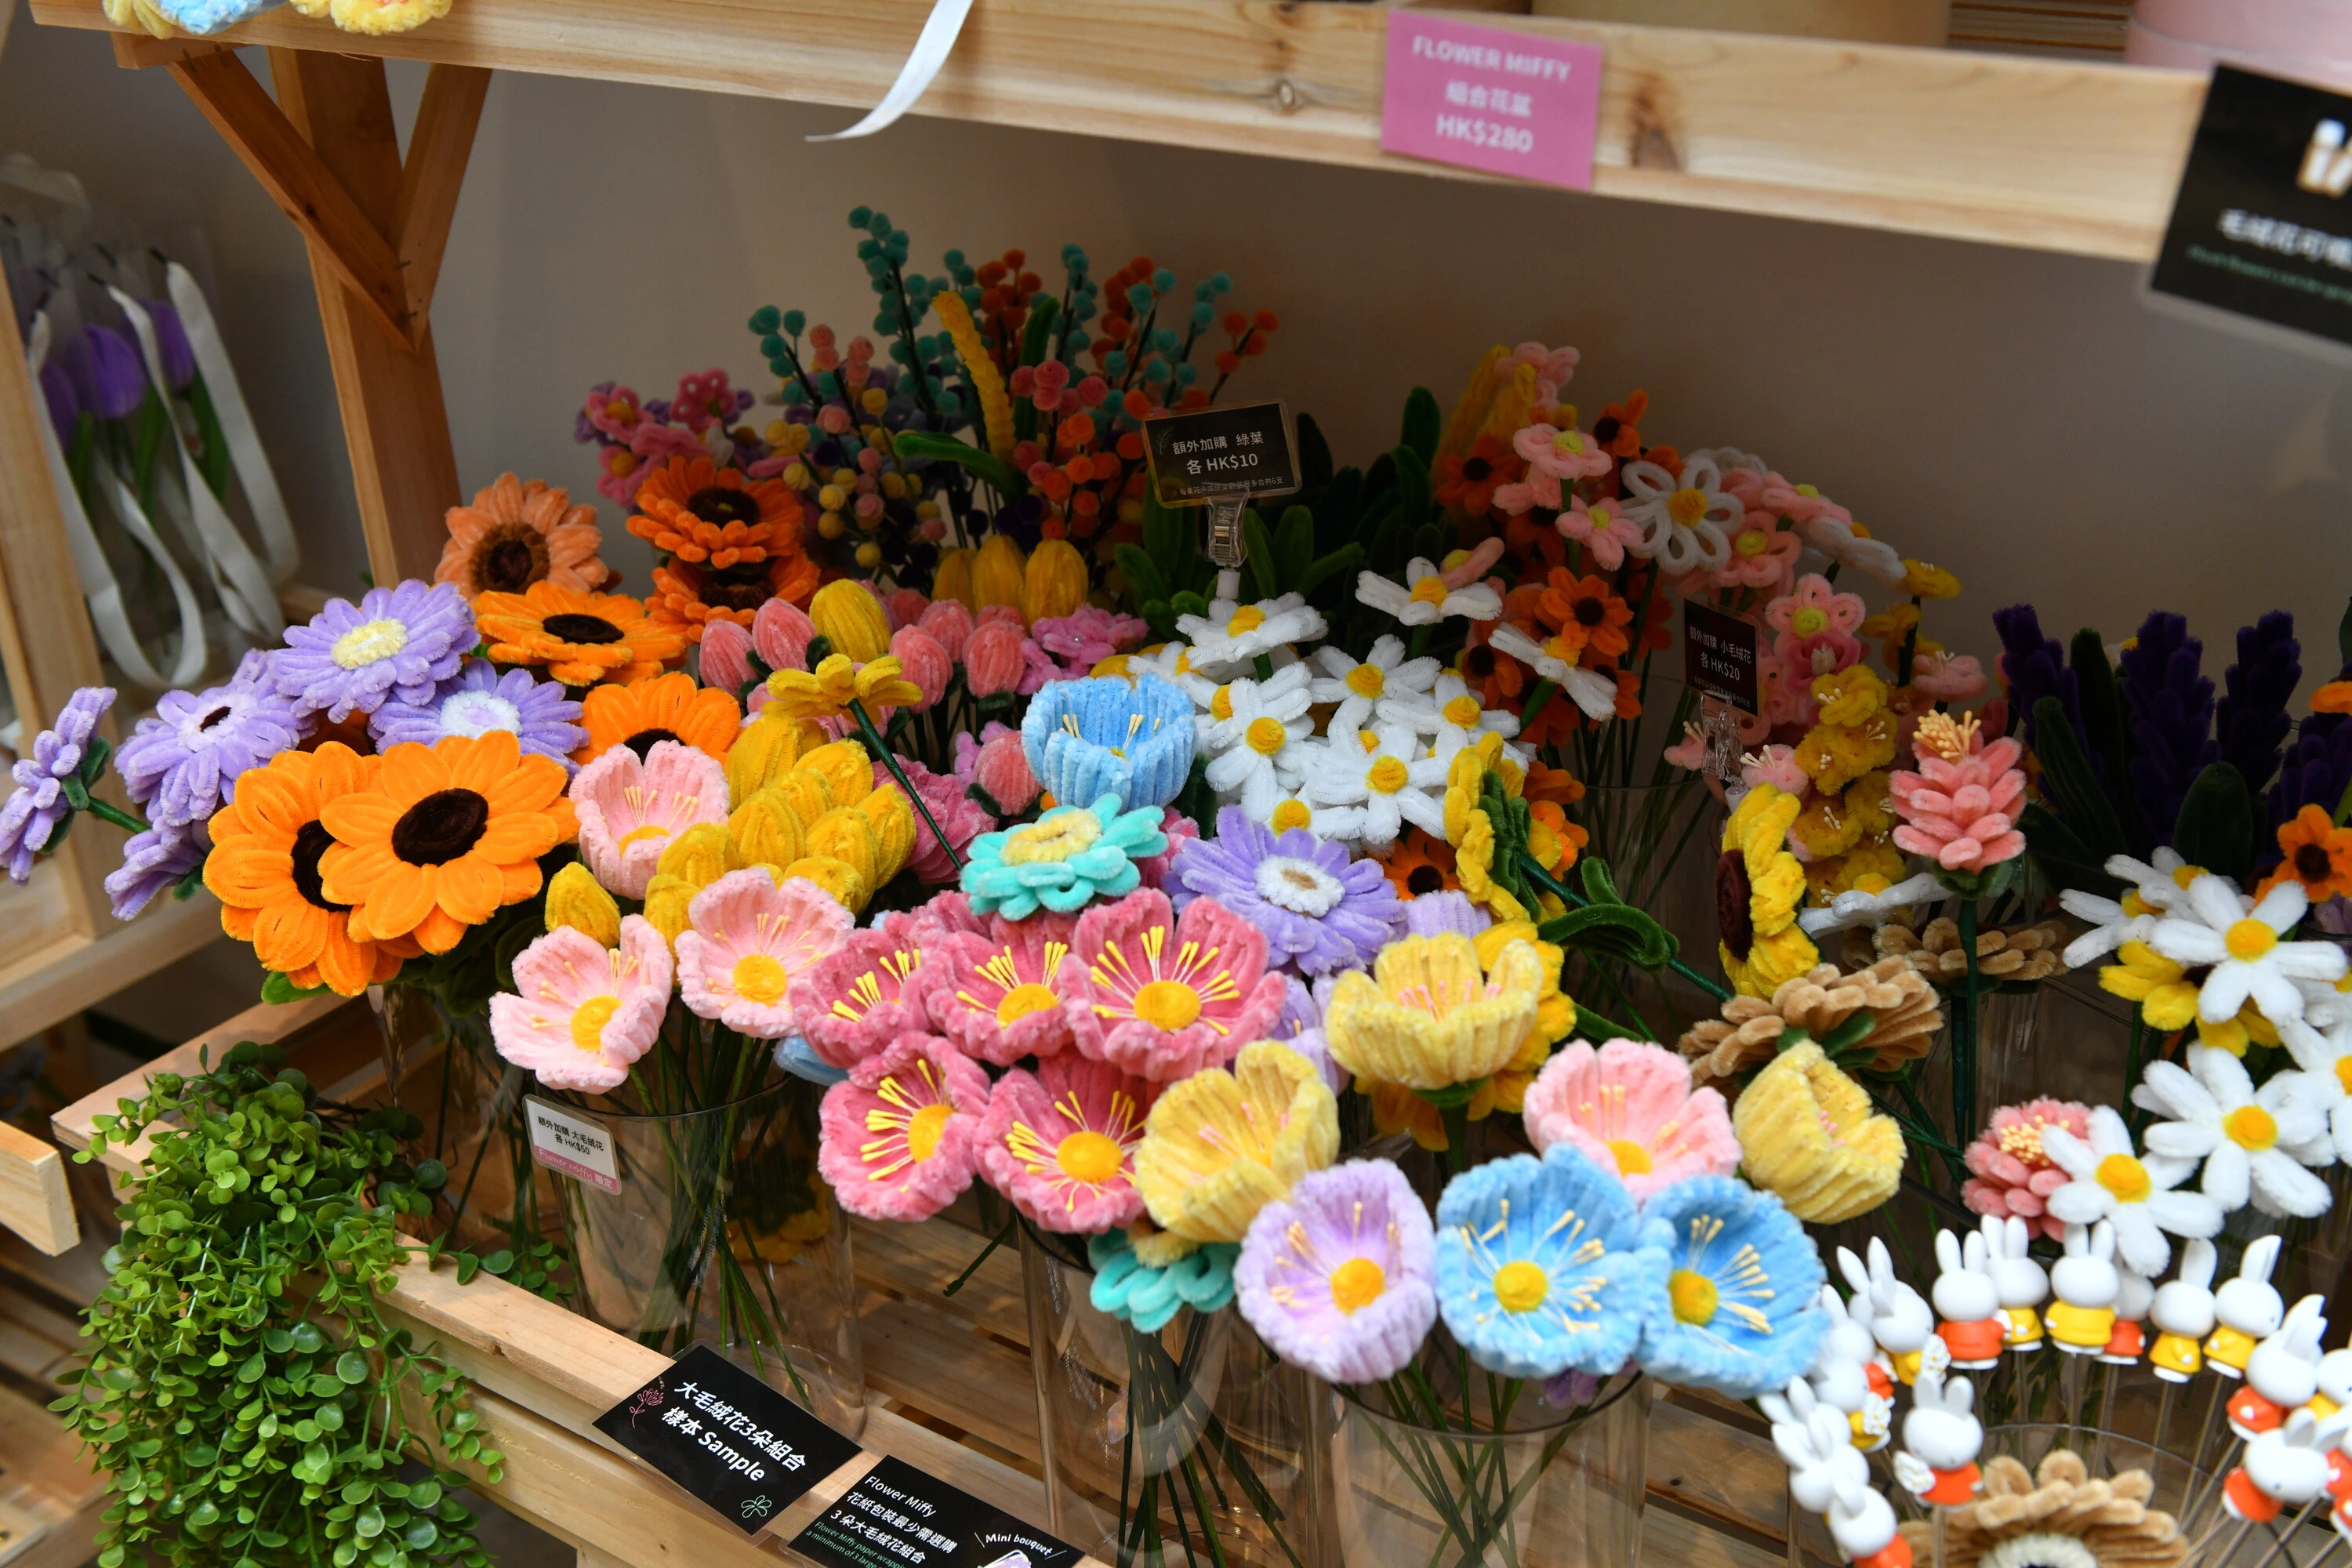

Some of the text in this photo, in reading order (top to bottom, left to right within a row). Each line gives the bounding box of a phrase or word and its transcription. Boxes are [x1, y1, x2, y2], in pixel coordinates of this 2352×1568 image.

[1413, 35, 1571, 82] FLOWER MIFFY
[1436, 114, 1534, 153] HK$280
[1173, 430, 1265, 456] 額外加購 綠葉
[1186, 453, 1258, 475] 各 HK$10
[1690, 626, 1751, 664] 額外加購 小毛絨花
[1700, 652, 1740, 681] 各 HK$20
[538, 1116, 604, 1151] 額外加購 大毛絨花
[555, 1134, 590, 1155] 各 HK$50
[539, 1148, 566, 1167] Flower
[594, 1174, 613, 1190] 限定
[661, 1406, 765, 1483] 樣本 Sample
[674, 1381, 807, 1473] 大毛絨花3朵組合
[864, 1475, 937, 1518] Flower Miffy
[814, 1521, 840, 1538] Flower
[839, 1533, 857, 1547] Miffy
[856, 1543, 879, 1558] paper
[830, 1509, 926, 1565] 3 朵大毛絨花組合
[846, 1491, 958, 1554] 花紙包裝最少需選購
[811, 1531, 844, 1553] minimum
[844, 1548, 854, 1557] of
[858, 1555, 877, 1568] large
[985, 1534, 1053, 1555] Mini bouquet
